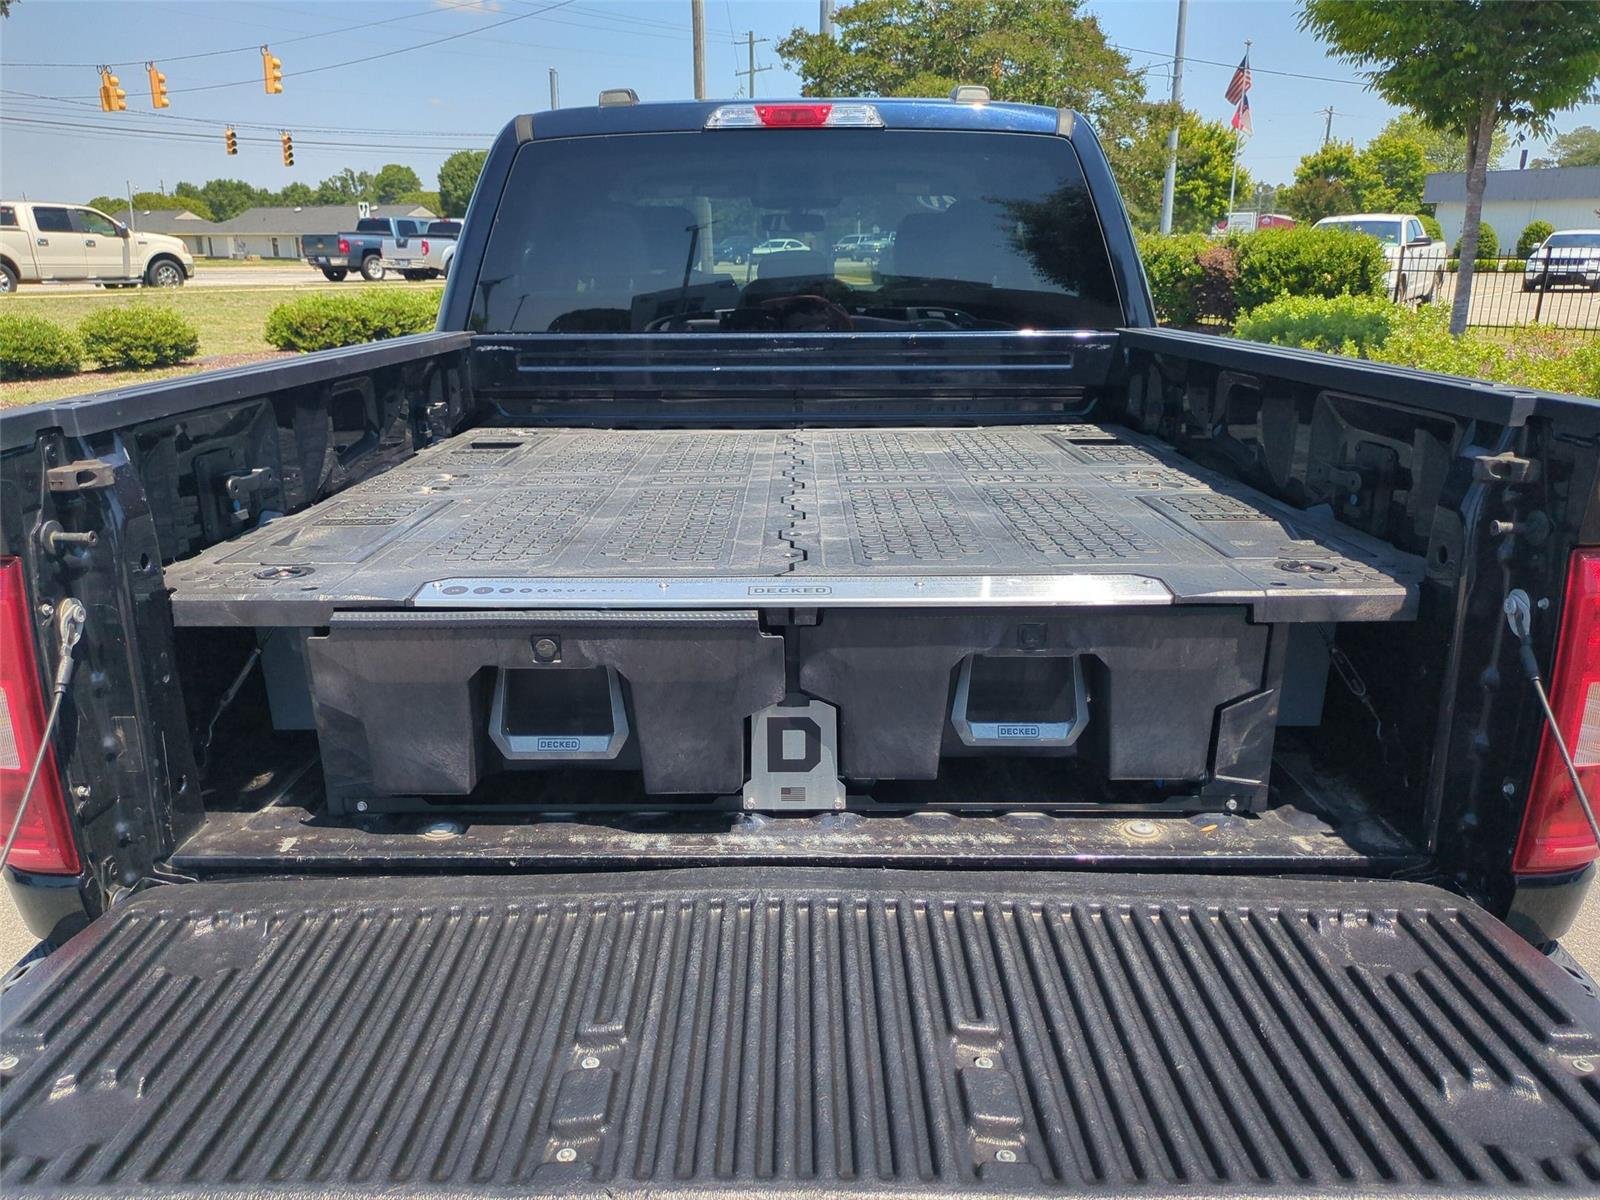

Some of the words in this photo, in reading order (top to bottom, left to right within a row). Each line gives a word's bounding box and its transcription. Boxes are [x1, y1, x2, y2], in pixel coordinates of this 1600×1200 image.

[1000, 727, 1037, 735] DECKED
[540, 740, 578, 748] DECKED
[767, 717, 821, 772] D
